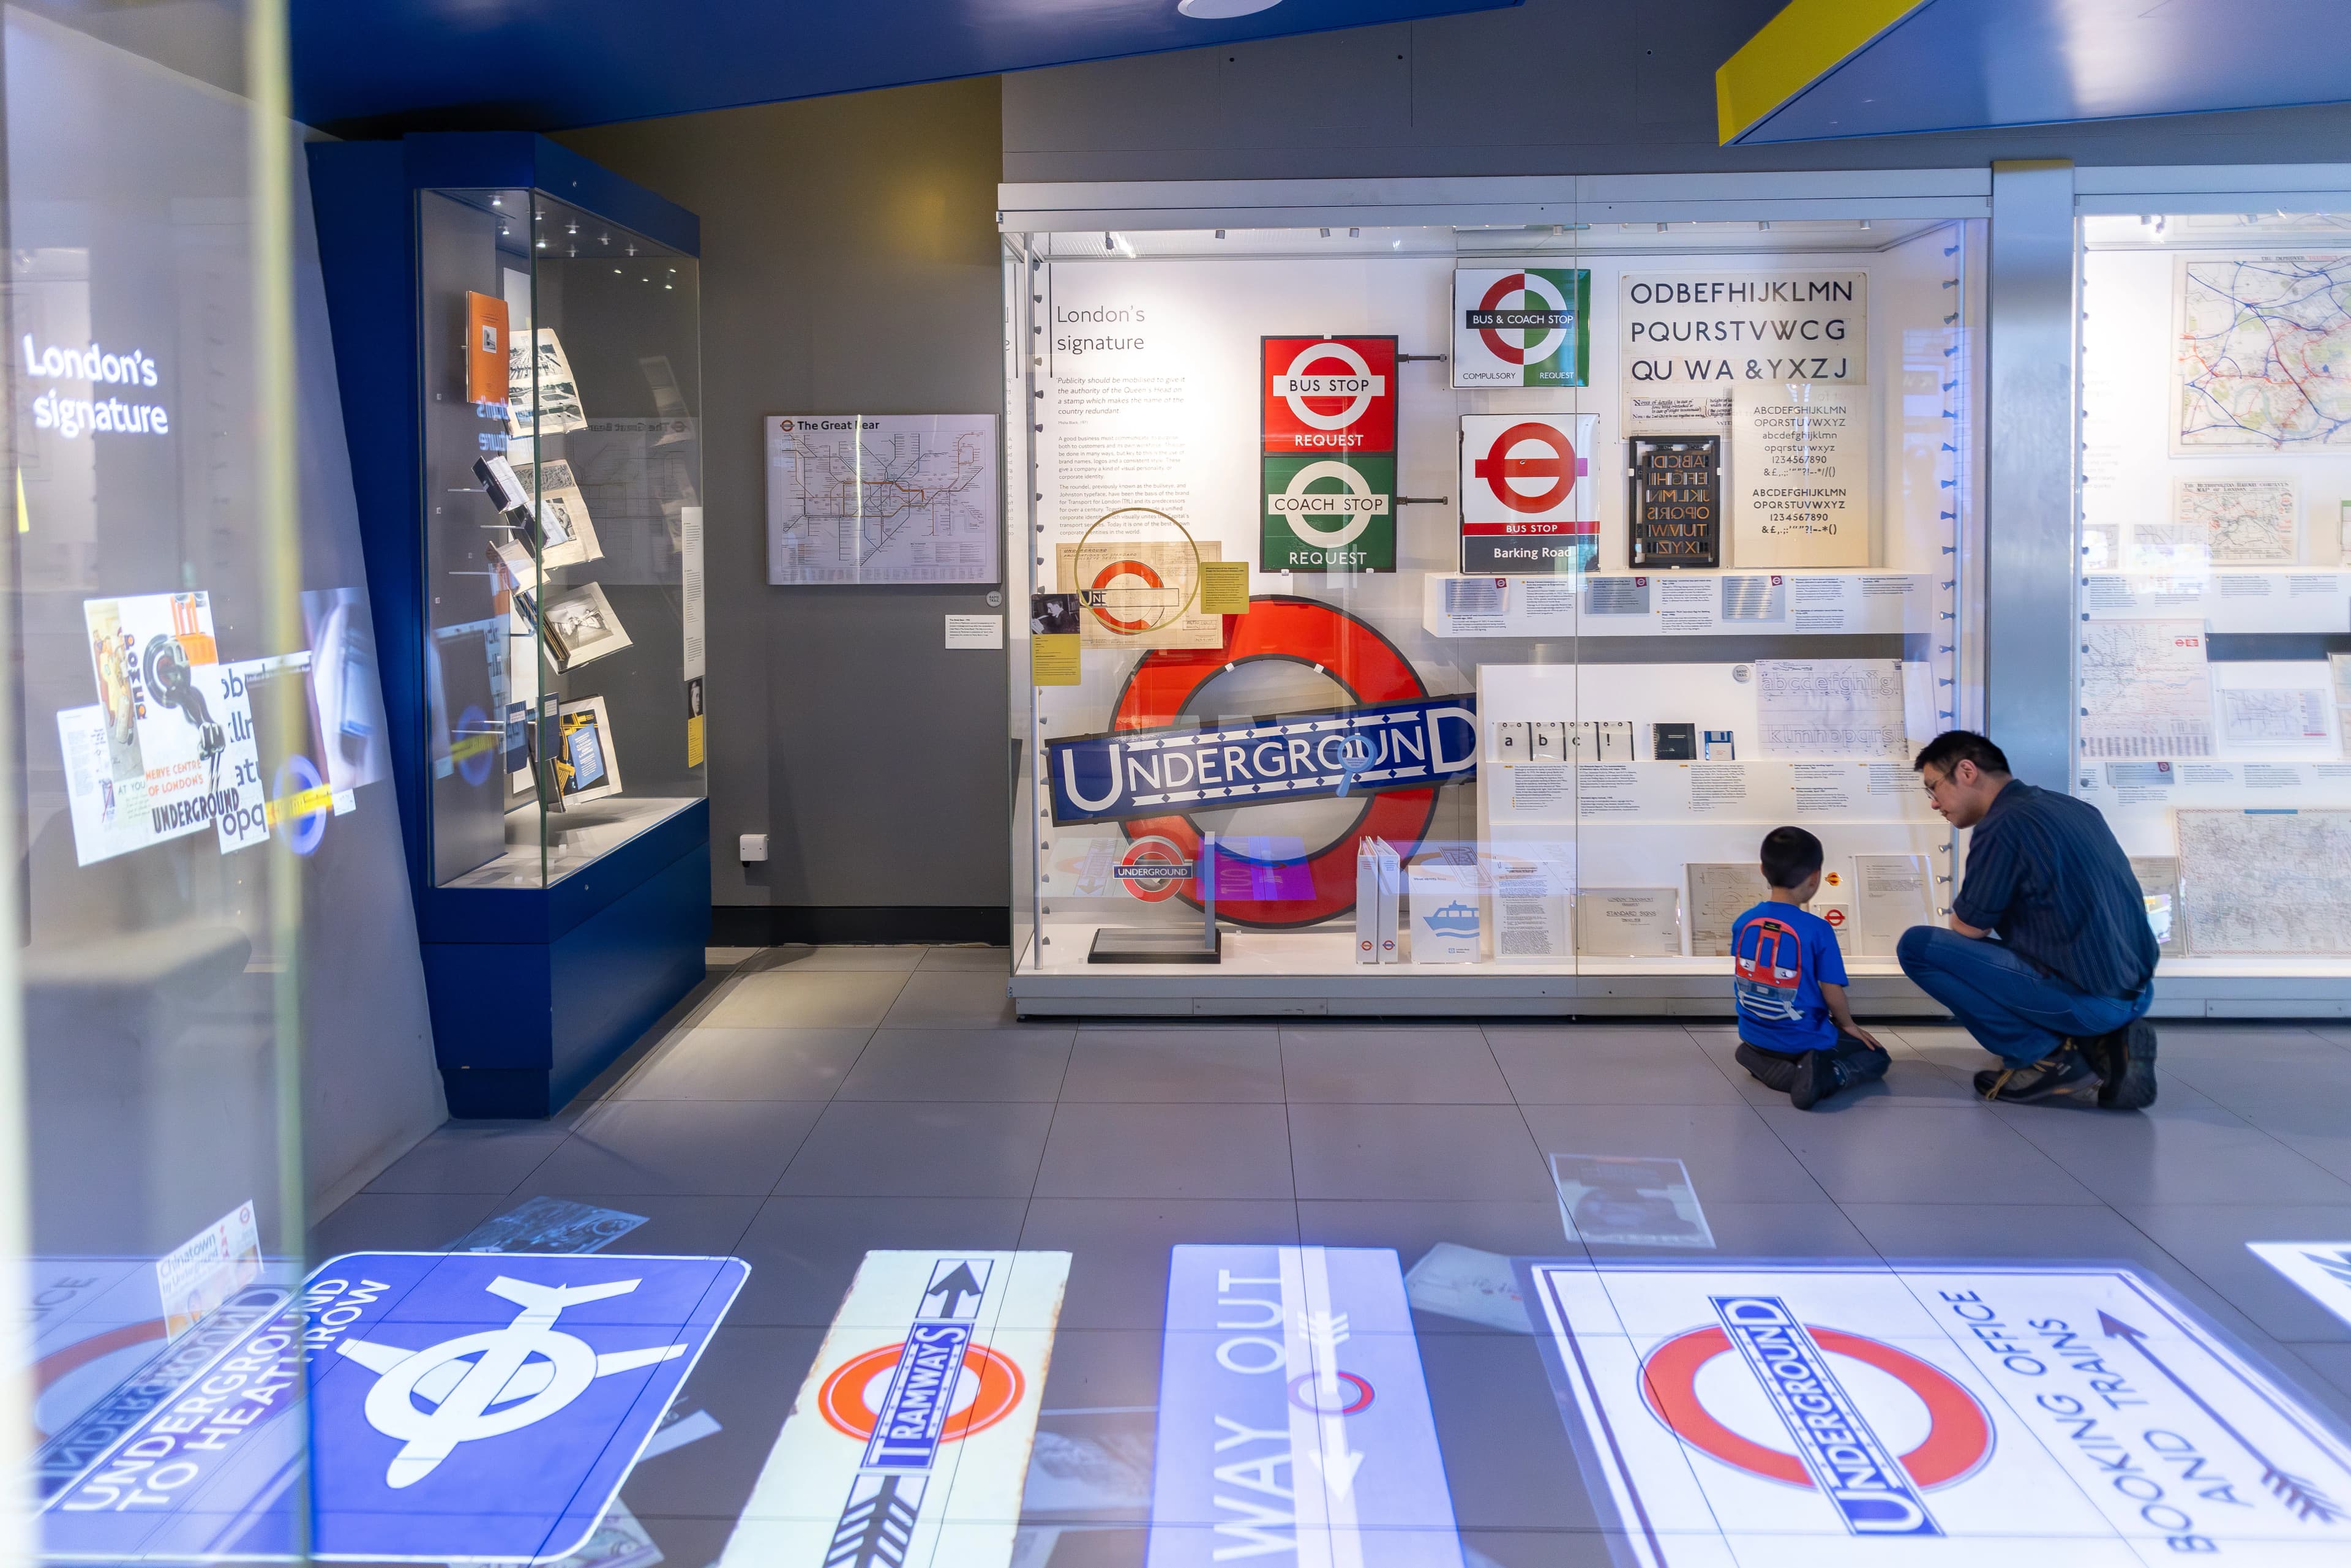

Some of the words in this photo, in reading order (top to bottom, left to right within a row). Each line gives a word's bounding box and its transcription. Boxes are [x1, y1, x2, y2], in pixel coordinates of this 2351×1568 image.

[1057, 306, 1145, 323] London's
[1473, 315, 1493, 324] BUS
[1496, 315, 1504, 324] &
[1507, 314, 1545, 324] COACH
[1548, 314, 1573, 324] STOP
[23, 333, 158, 386] London's
[1057, 336, 1144, 354] signature
[1290, 380, 1320, 392] BUS
[1329, 379, 1369, 392] STOP
[33, 388, 168, 438] signature
[798, 421, 818, 430] The
[821, 421, 852, 430] Great
[856, 420, 880, 430] ear
[1295, 435, 1363, 446] REQUEST
[1275, 498, 1334, 511] COACH
[1344, 498, 1382, 511] STOP
[1506, 525, 1529, 533] BUS
[1531, 525, 1558, 533] STOP
[1289, 552, 1367, 565] REQUEST
[1494, 548, 1539, 560] Barking
[1542, 547, 1572, 558] Road
[1062, 707, 1477, 812] UNDERGROUND
[1505, 737, 1513, 746] a
[1539, 733, 1548, 746] b
[152, 787, 239, 834] UNDERGROUND
[1118, 867, 1188, 877] UNDERGROUND
[1215, 1269, 1288, 1373] OUT
[1938, 1289, 2047, 1377] OFFICE
[2028, 1317, 2150, 1411] TRAINS
[63, 1278, 349, 1511] UNDERGROUND
[869, 1327, 967, 1466] TRAMWAYS
[1723, 1299, 1925, 1532] UNDERGROUND
[116, 1462, 199, 1512] TO
[1213, 1415, 1298, 1562] WAY
[2036, 1392, 2222, 1554] BOOKING
[2144, 1428, 2256, 1508] AND
